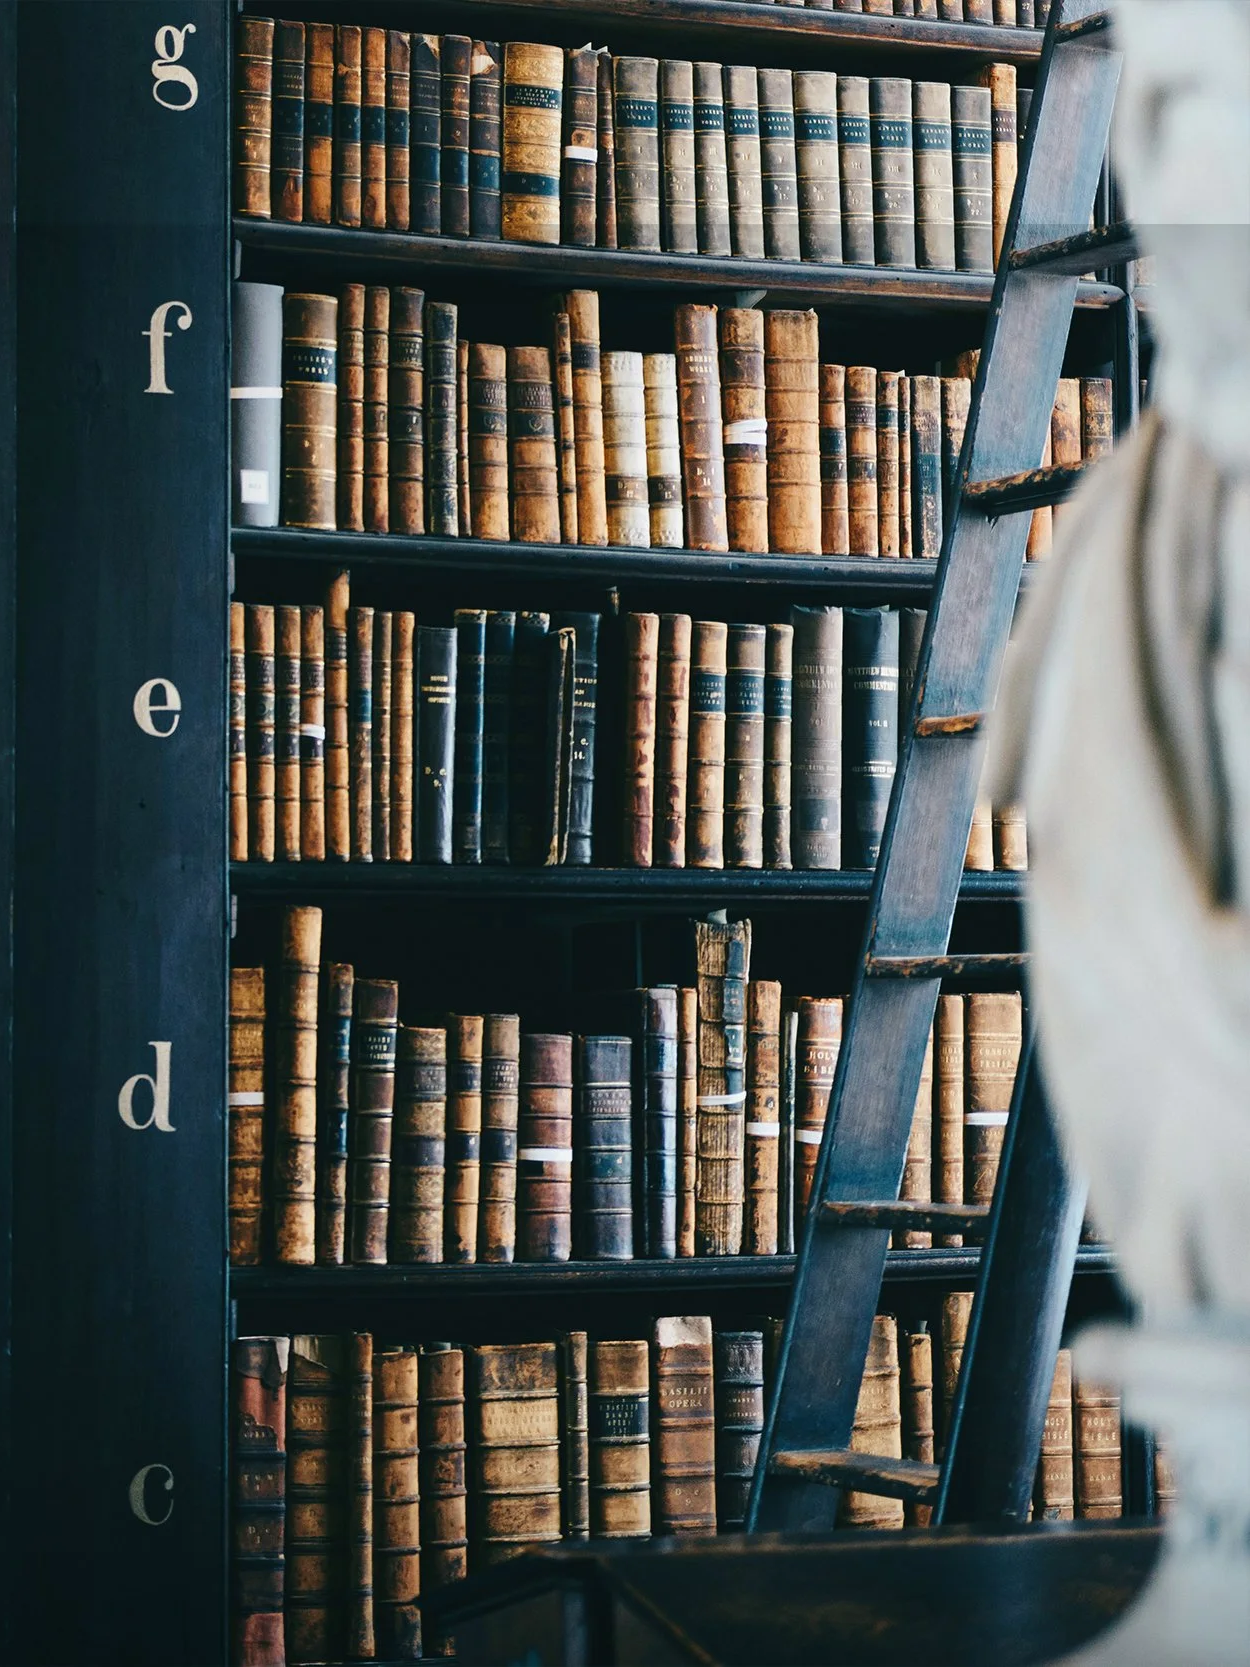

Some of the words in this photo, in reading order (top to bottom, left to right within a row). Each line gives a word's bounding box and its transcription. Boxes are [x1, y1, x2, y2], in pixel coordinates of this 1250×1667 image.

[1022, 2, 1030, 10] 27
[151, 23, 198, 111] g
[142, 301, 192, 394] f
[133, 677, 182, 738] e
[118, 1041, 176, 1132] d
[803, 1065, 834, 1075] BIBL
[669, 1400, 702, 1408] OPERA
[1085, 1432, 1116, 1441] BIBLE
[1087, 1418, 1111, 1426] HOLY
[129, 1464, 174, 1526] c
